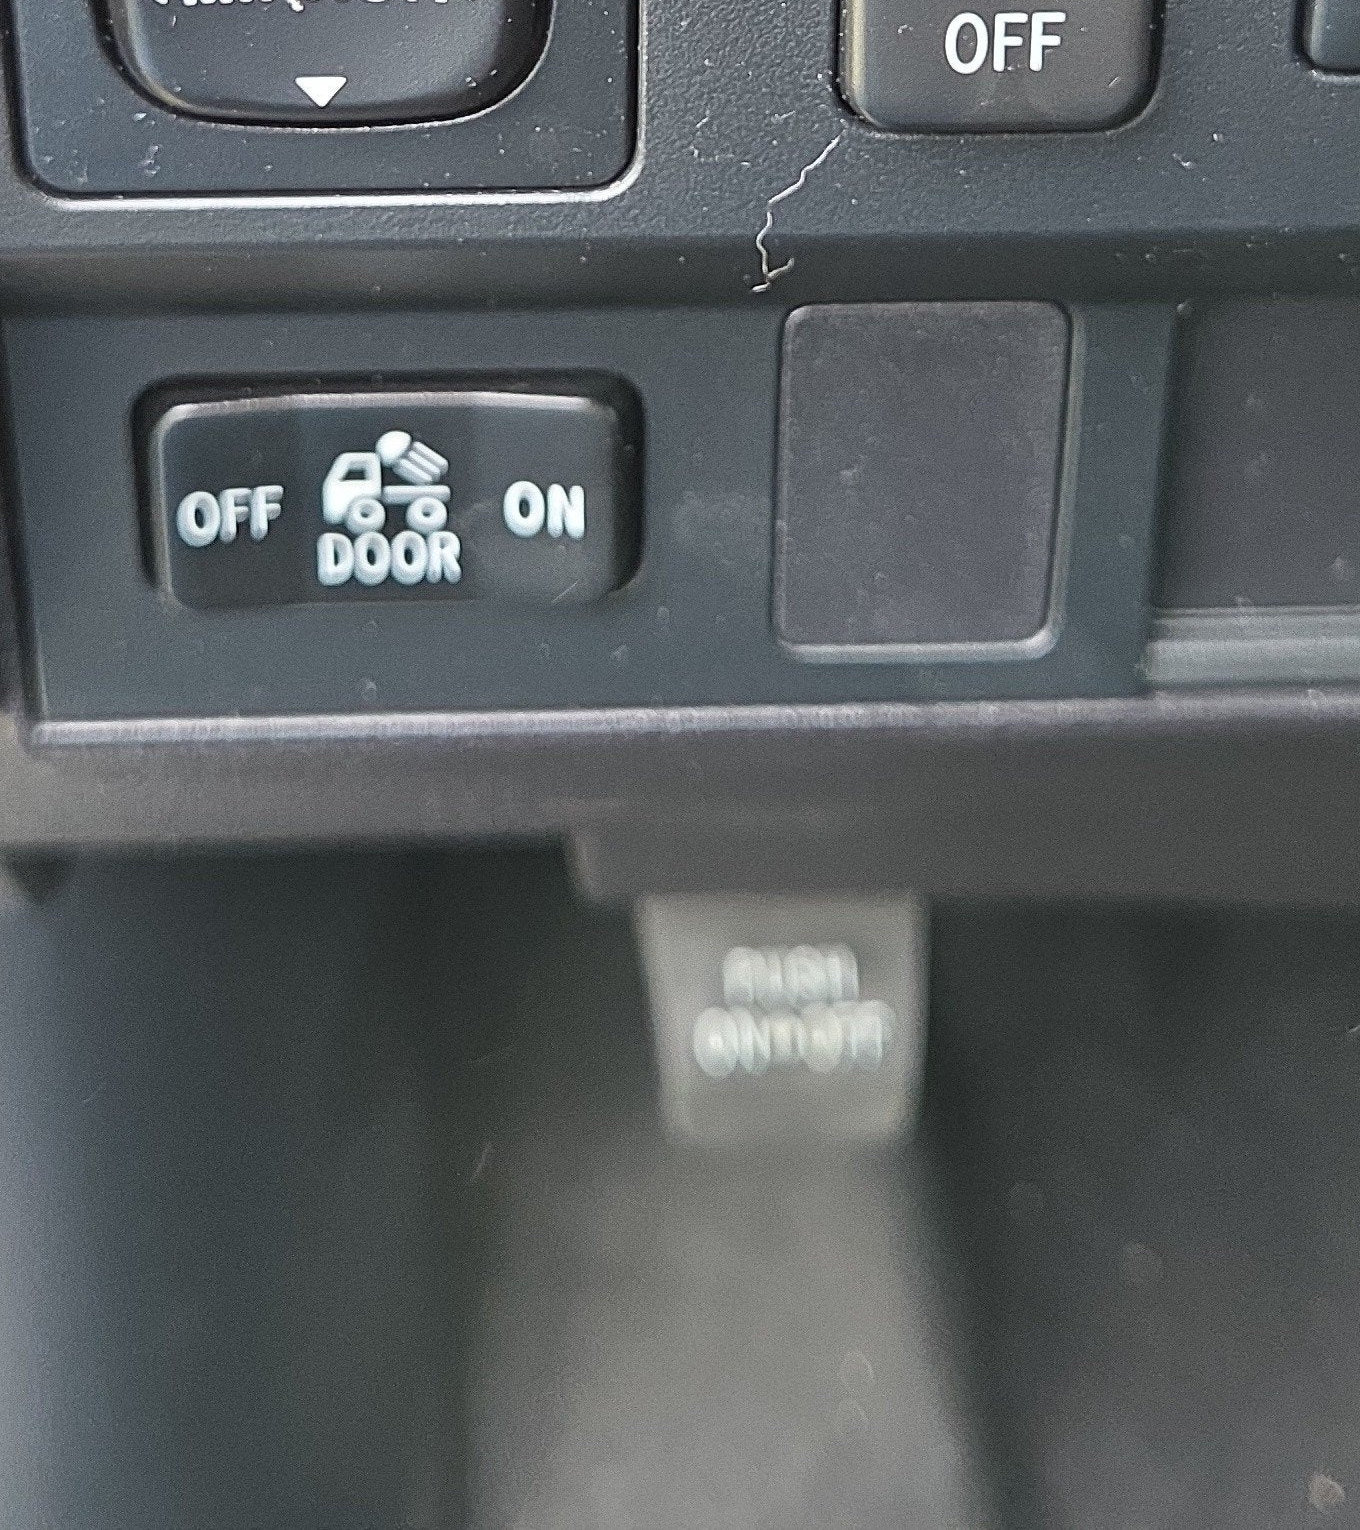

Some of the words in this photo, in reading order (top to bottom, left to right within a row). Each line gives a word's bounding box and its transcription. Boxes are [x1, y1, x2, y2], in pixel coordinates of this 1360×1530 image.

[944, 11, 1067, 75] OFF
[177, 484, 284, 547] OFF
[503, 480, 585, 539] ON
[316, 531, 462, 586] DOOR
